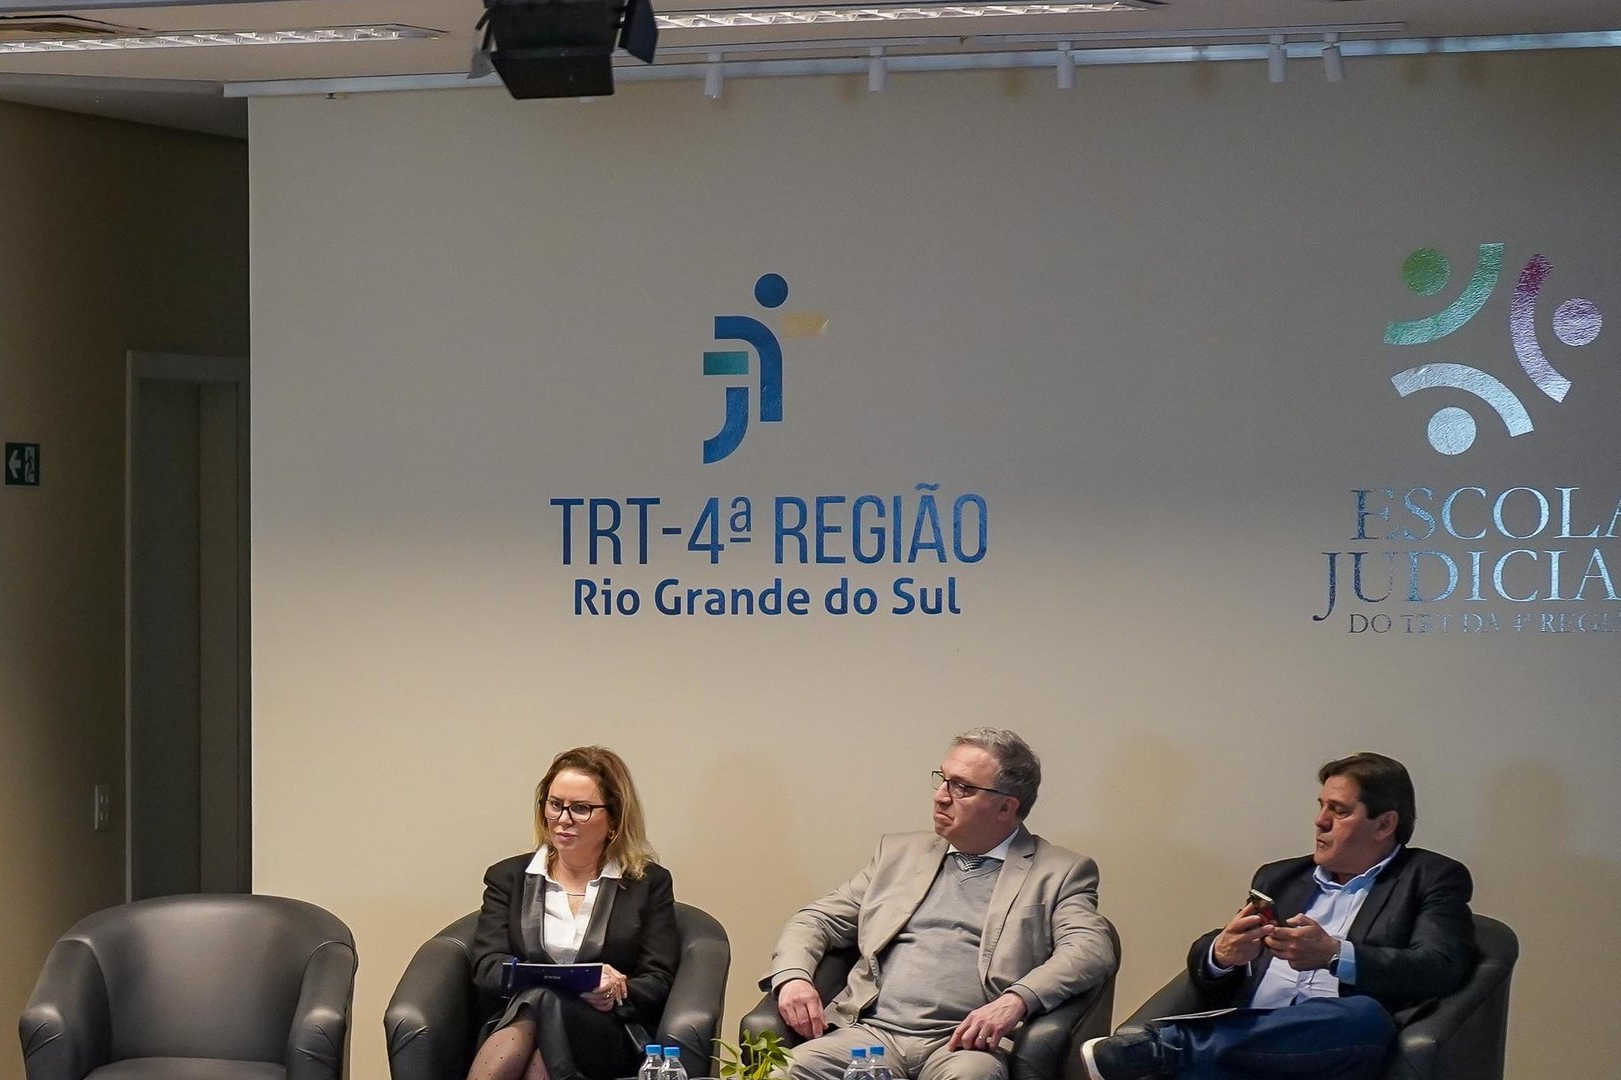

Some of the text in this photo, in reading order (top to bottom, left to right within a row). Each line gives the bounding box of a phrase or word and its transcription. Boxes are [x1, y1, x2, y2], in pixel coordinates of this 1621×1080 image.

[550, 481, 989, 565] TRT-4ª REGIÃO
[574, 577, 961, 616] Rio Grande do Sul
[1312, 548, 1621, 622] JUDICIA
[1348, 613, 1392, 634] DO
